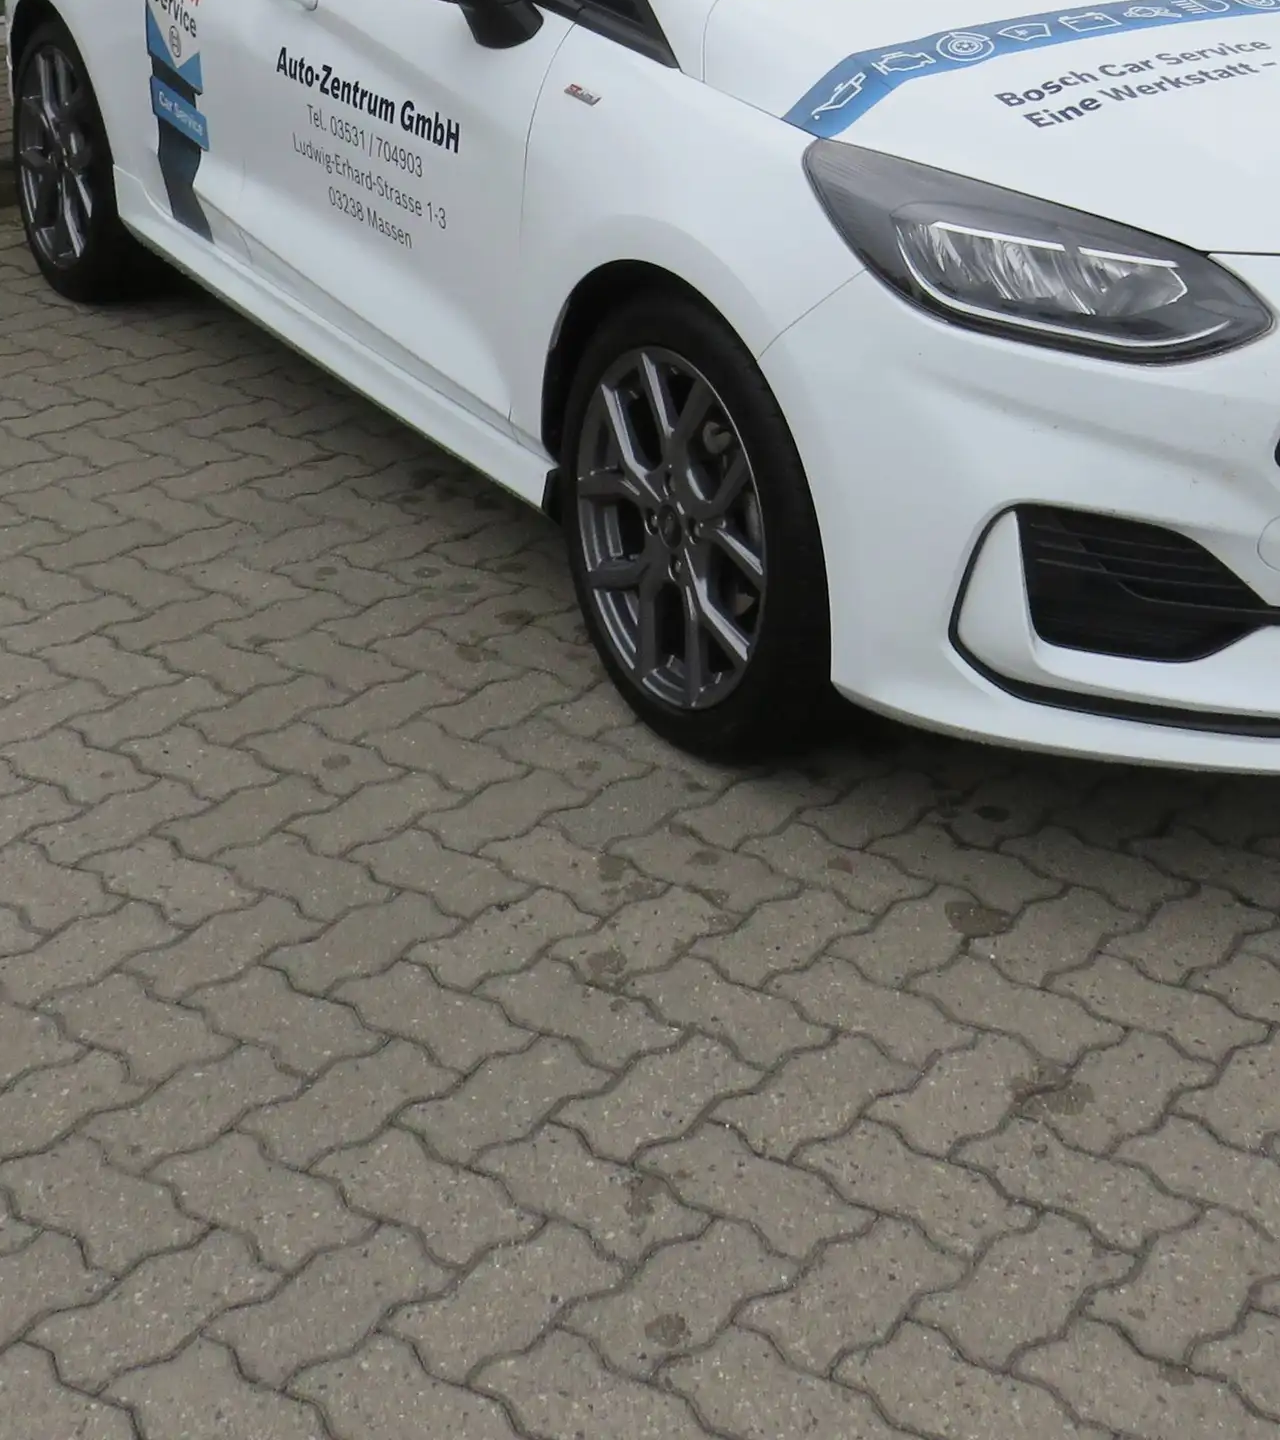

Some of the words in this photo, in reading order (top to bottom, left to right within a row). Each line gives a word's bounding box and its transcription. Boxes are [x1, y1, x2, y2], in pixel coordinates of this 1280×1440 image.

[276, 46, 396, 125] Auto-Zentrum
[400, 100, 461, 155] GmbH
[994, 70, 1100, 108] Bosch
[1098, 58, 1156, 78] Car
[1155, 40, 1272, 66] Service
[1023, 97, 1103, 129] Eine
[1096, 61, 1261, 102] Werkstatt
[307, 103, 327, 132] Tel.
[330, 115, 366, 151] 03531
[375, 135, 424, 179] 704903
[292, 131, 423, 218] Ludwig-Erhard-Strasse
[426, 201, 448, 231] 1-3
[328, 186, 365, 223] 03238
[366, 206, 413, 250] Massen
